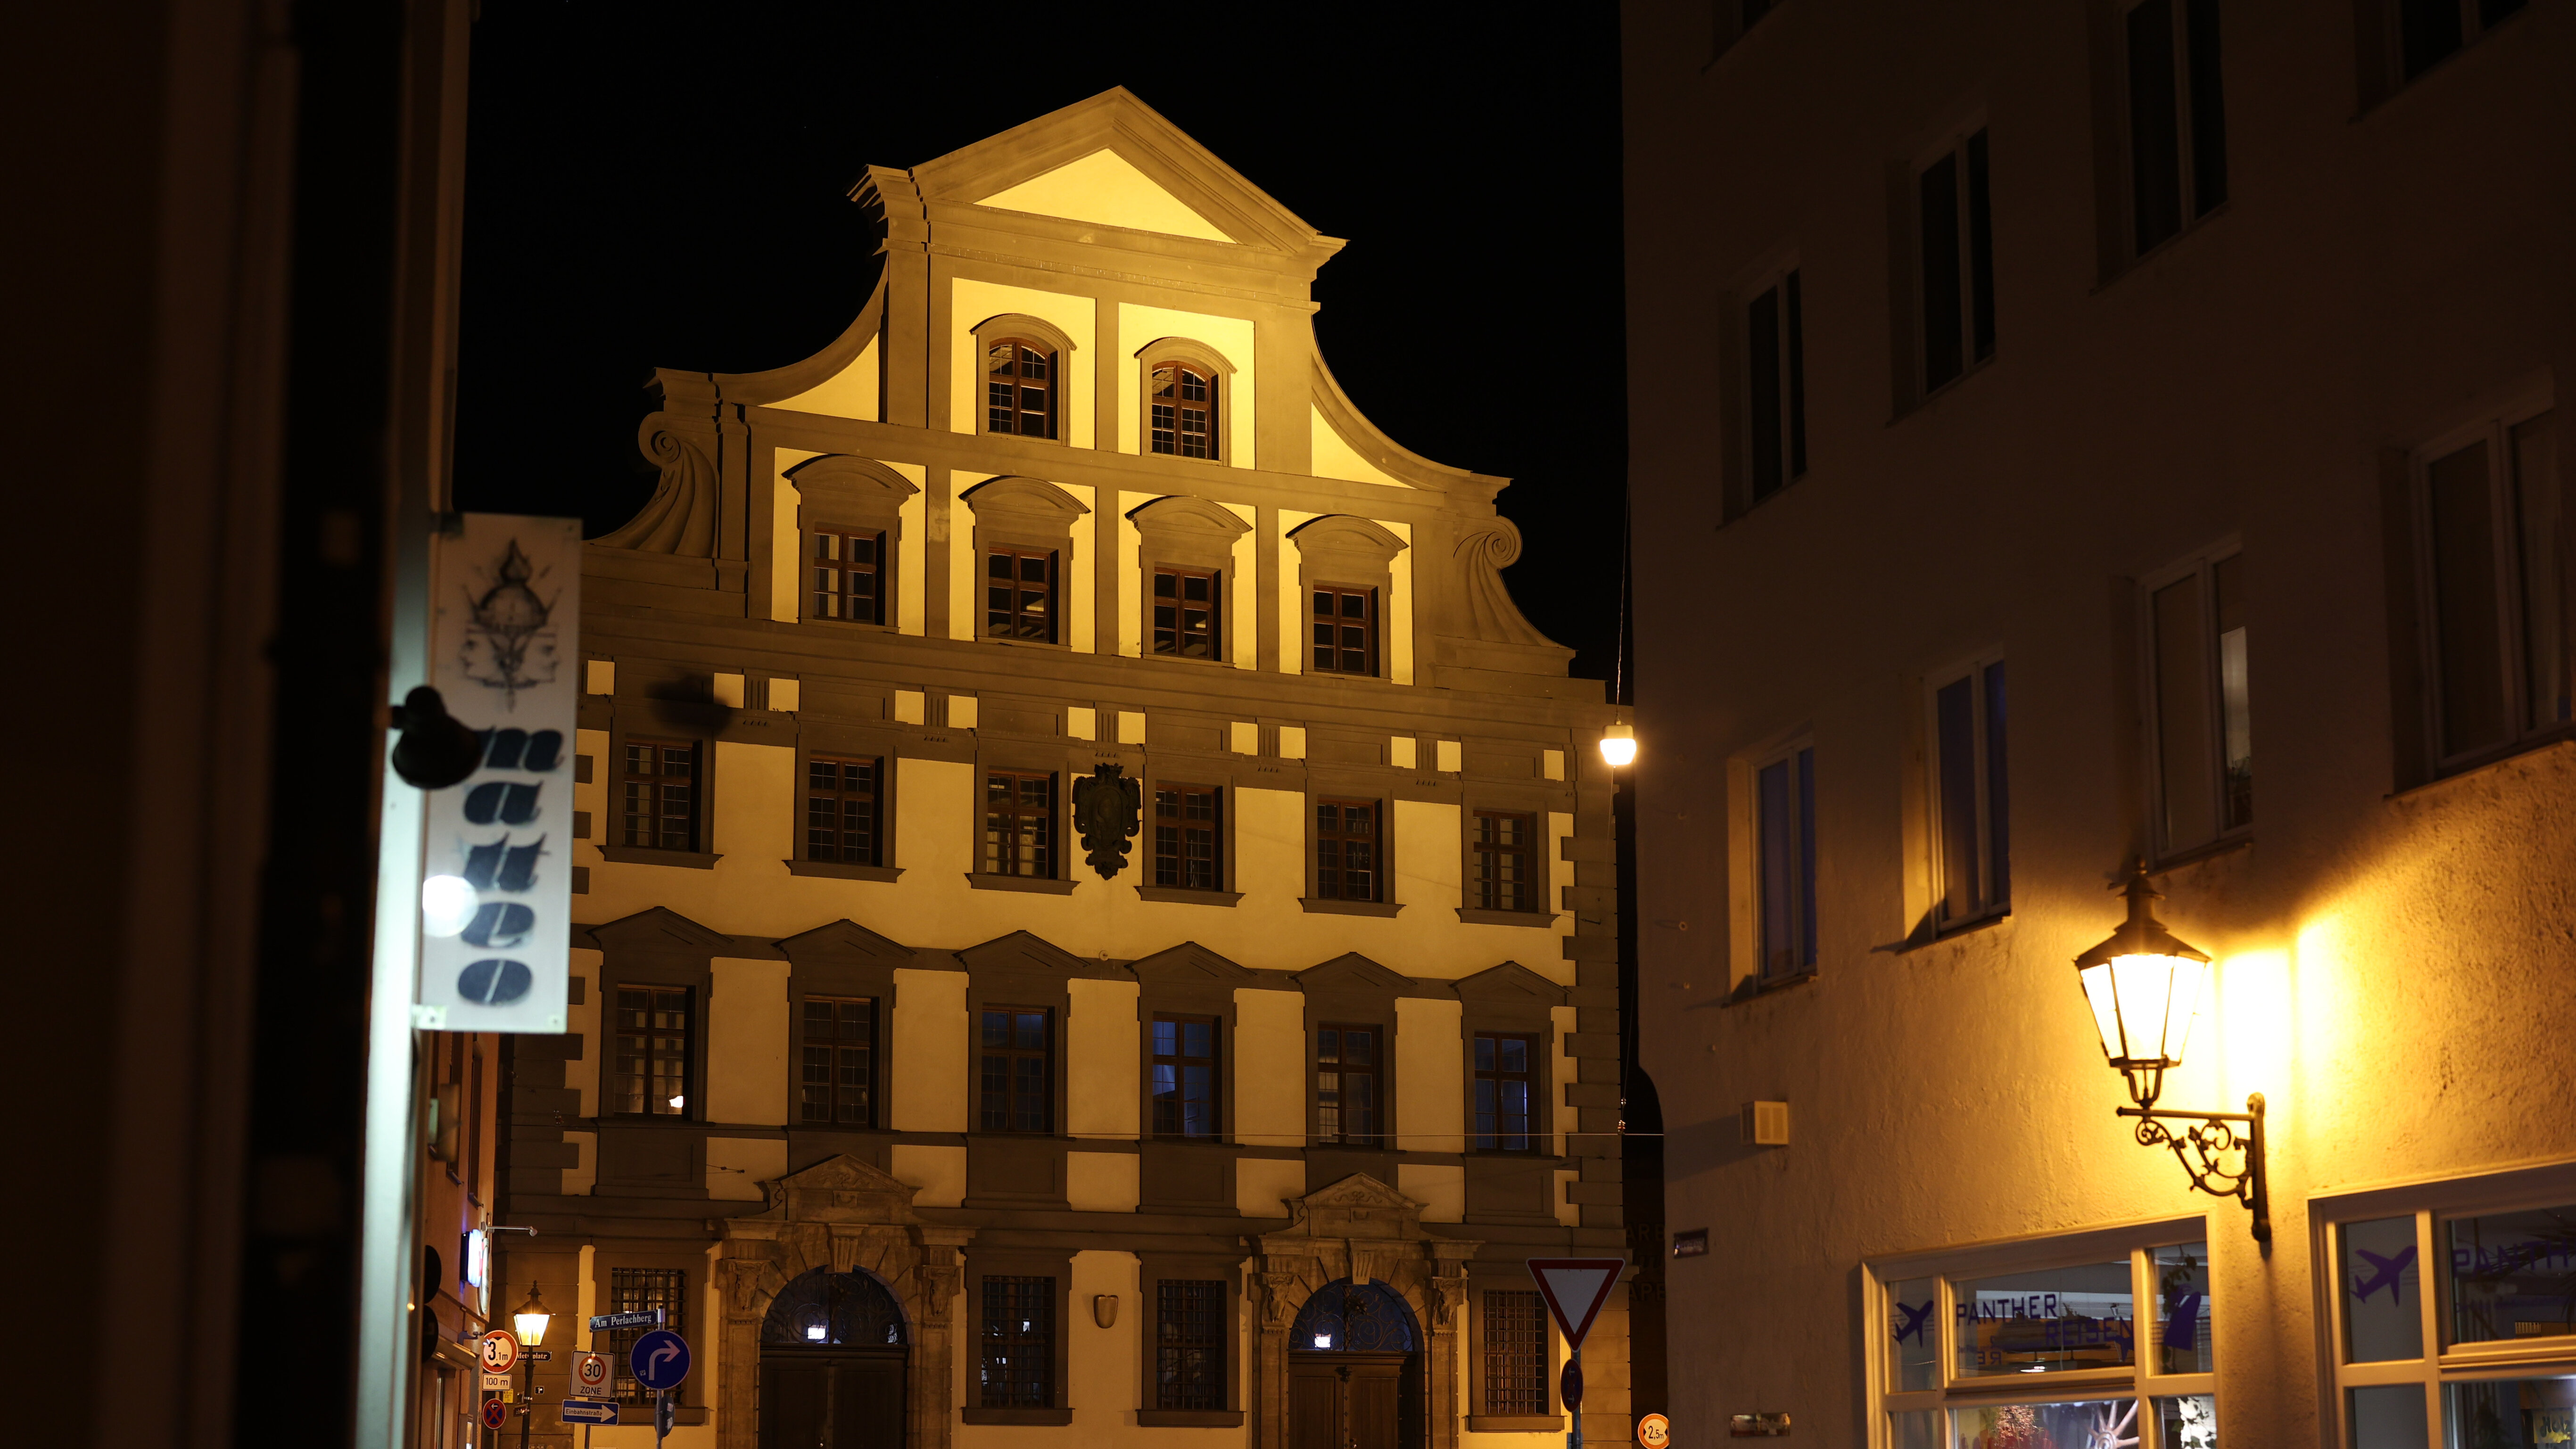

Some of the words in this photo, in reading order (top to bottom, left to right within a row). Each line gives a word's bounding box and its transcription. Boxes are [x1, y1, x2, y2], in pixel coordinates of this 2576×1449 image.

[1957, 1294, 2057, 1326] PANTHER
[594, 1318, 607, 1328] Am
[611, 1314, 652, 1326] Perlachberg
[2045, 1315, 2133, 1347] REISEN
[584, 1363, 601, 1378] 30
[486, 1377, 498, 1386] 100
[580, 1386, 602, 1395] ZONE
[565, 1408, 603, 1417] Einbahnstraße
[1648, 1425, 1664, 1440] 2,5m
